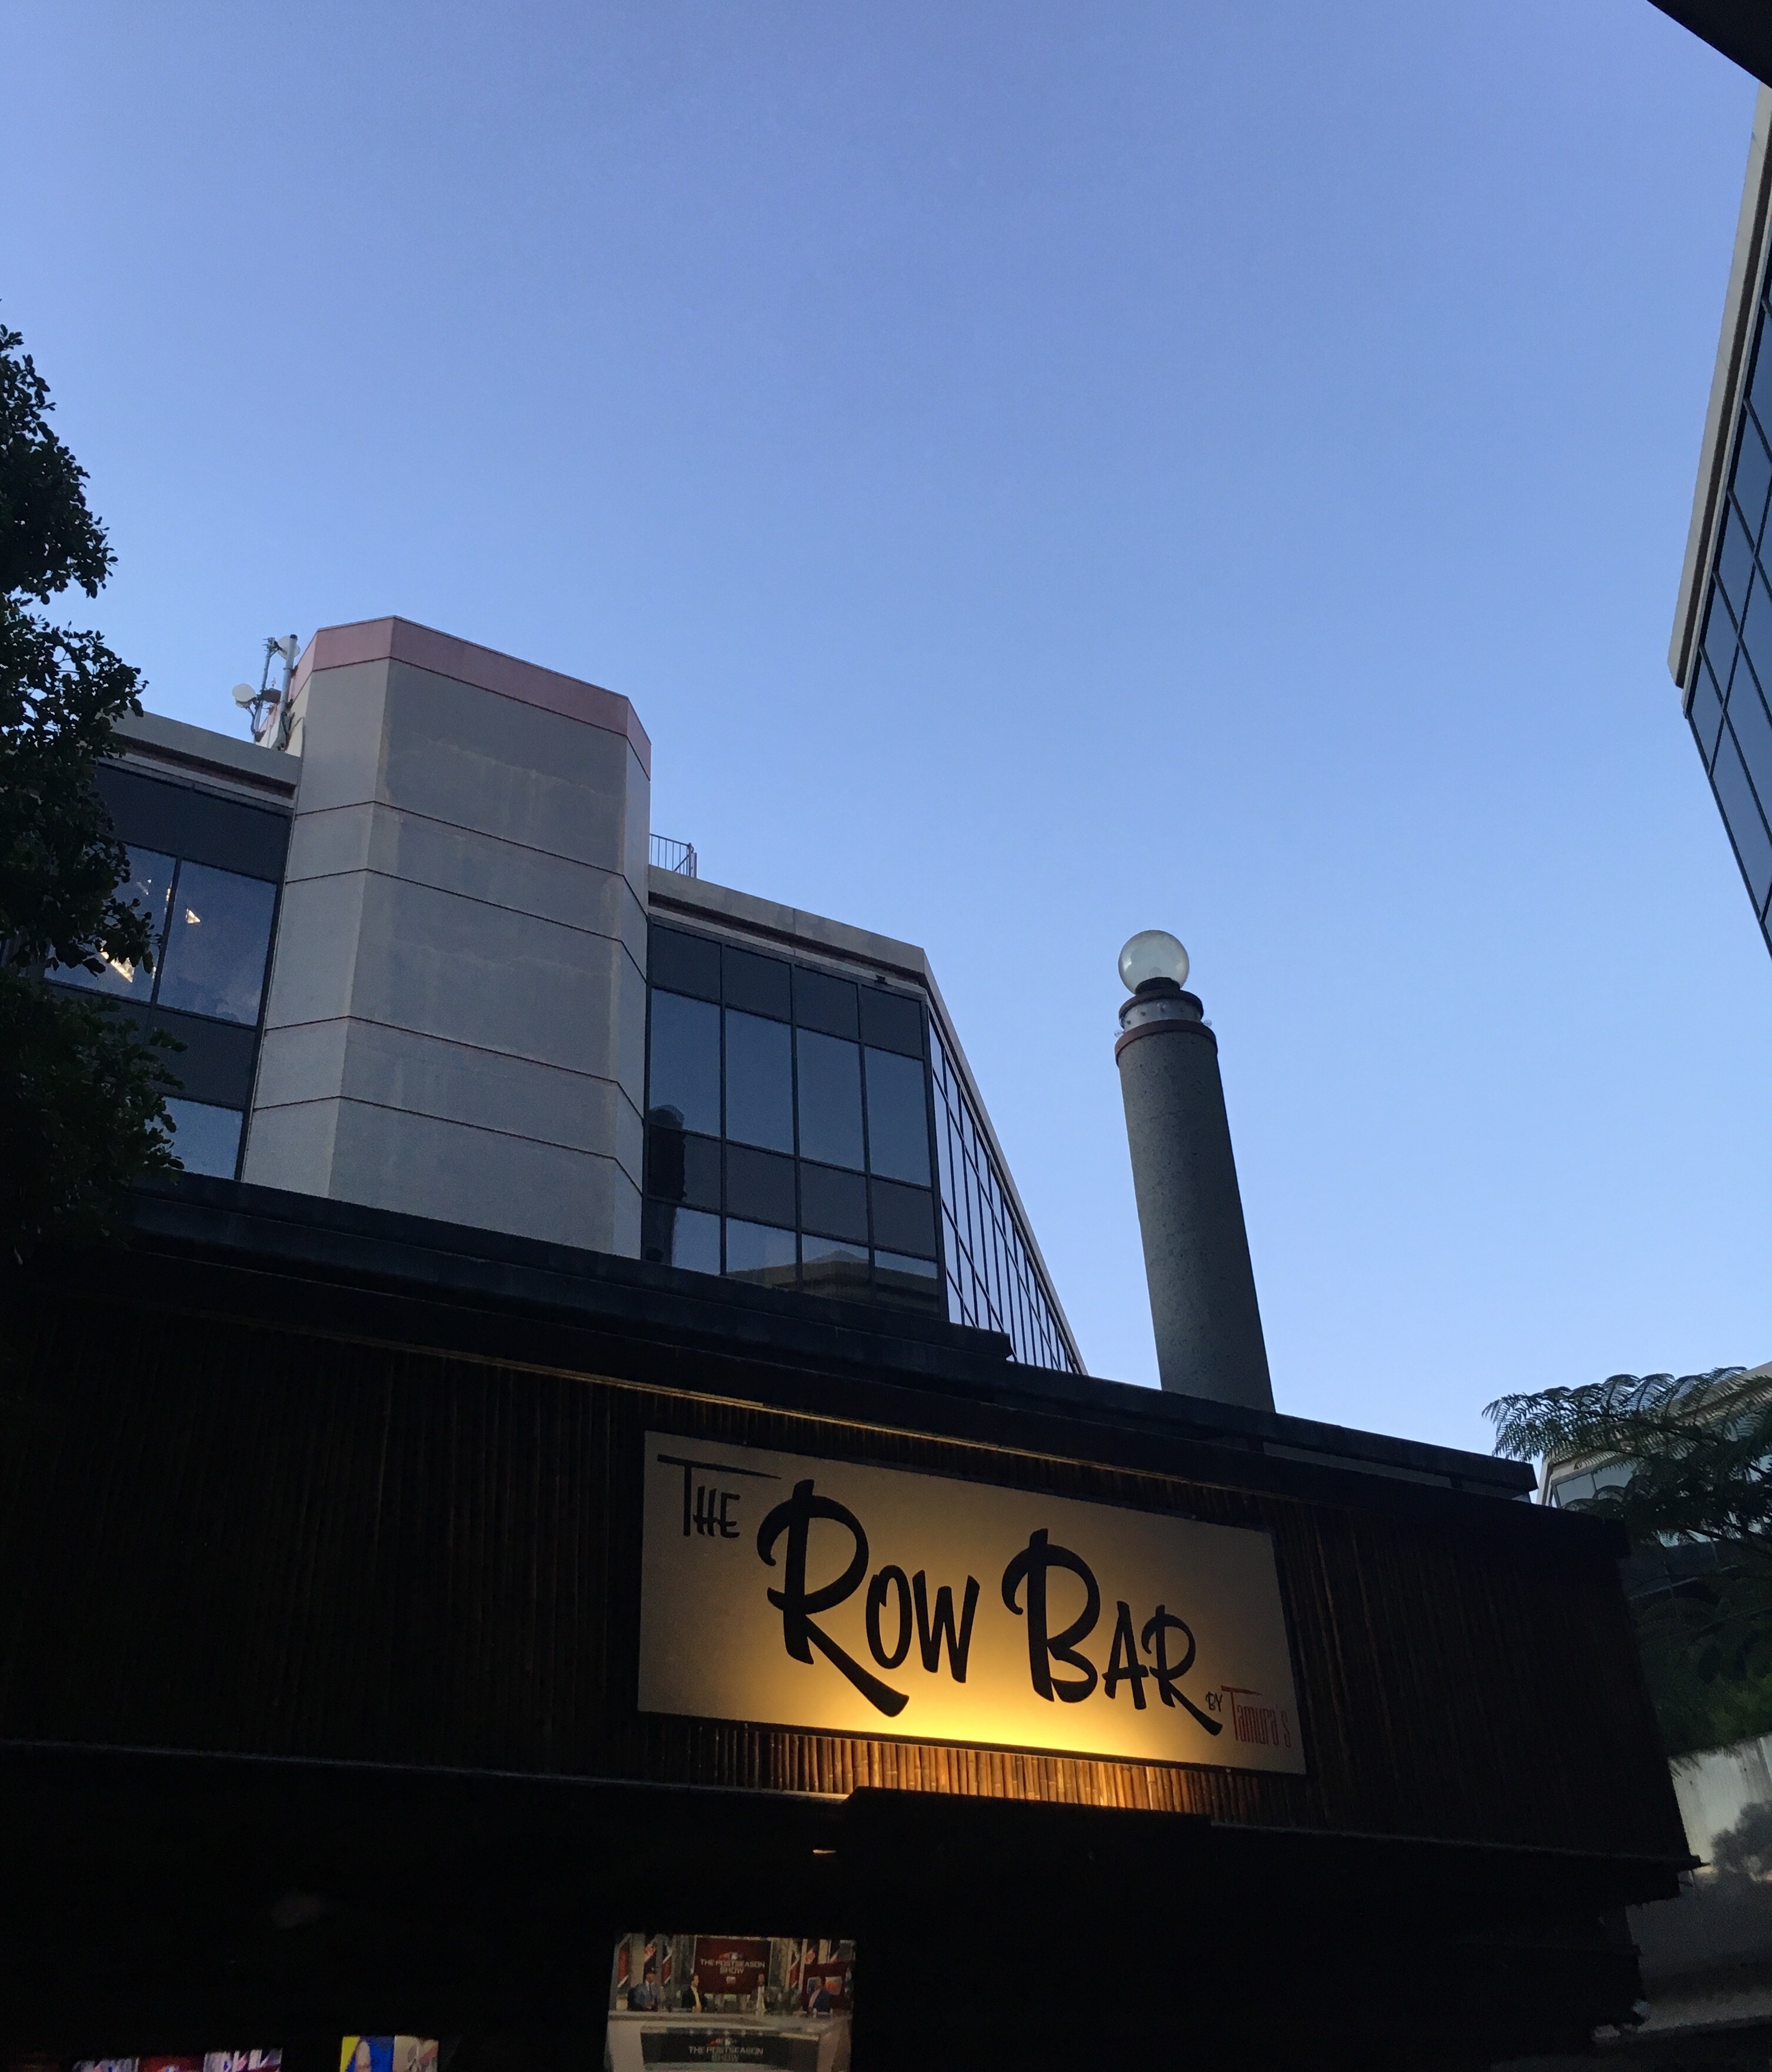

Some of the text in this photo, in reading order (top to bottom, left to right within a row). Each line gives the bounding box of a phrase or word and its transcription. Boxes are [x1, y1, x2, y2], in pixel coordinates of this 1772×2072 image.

[657, 1454, 1223, 1736] THE ROW BAR
[1206, 1685, 1291, 1747] BY Tamura's
[700, 1958, 714, 1967] THE
[688, 2046, 704, 2054] THE
